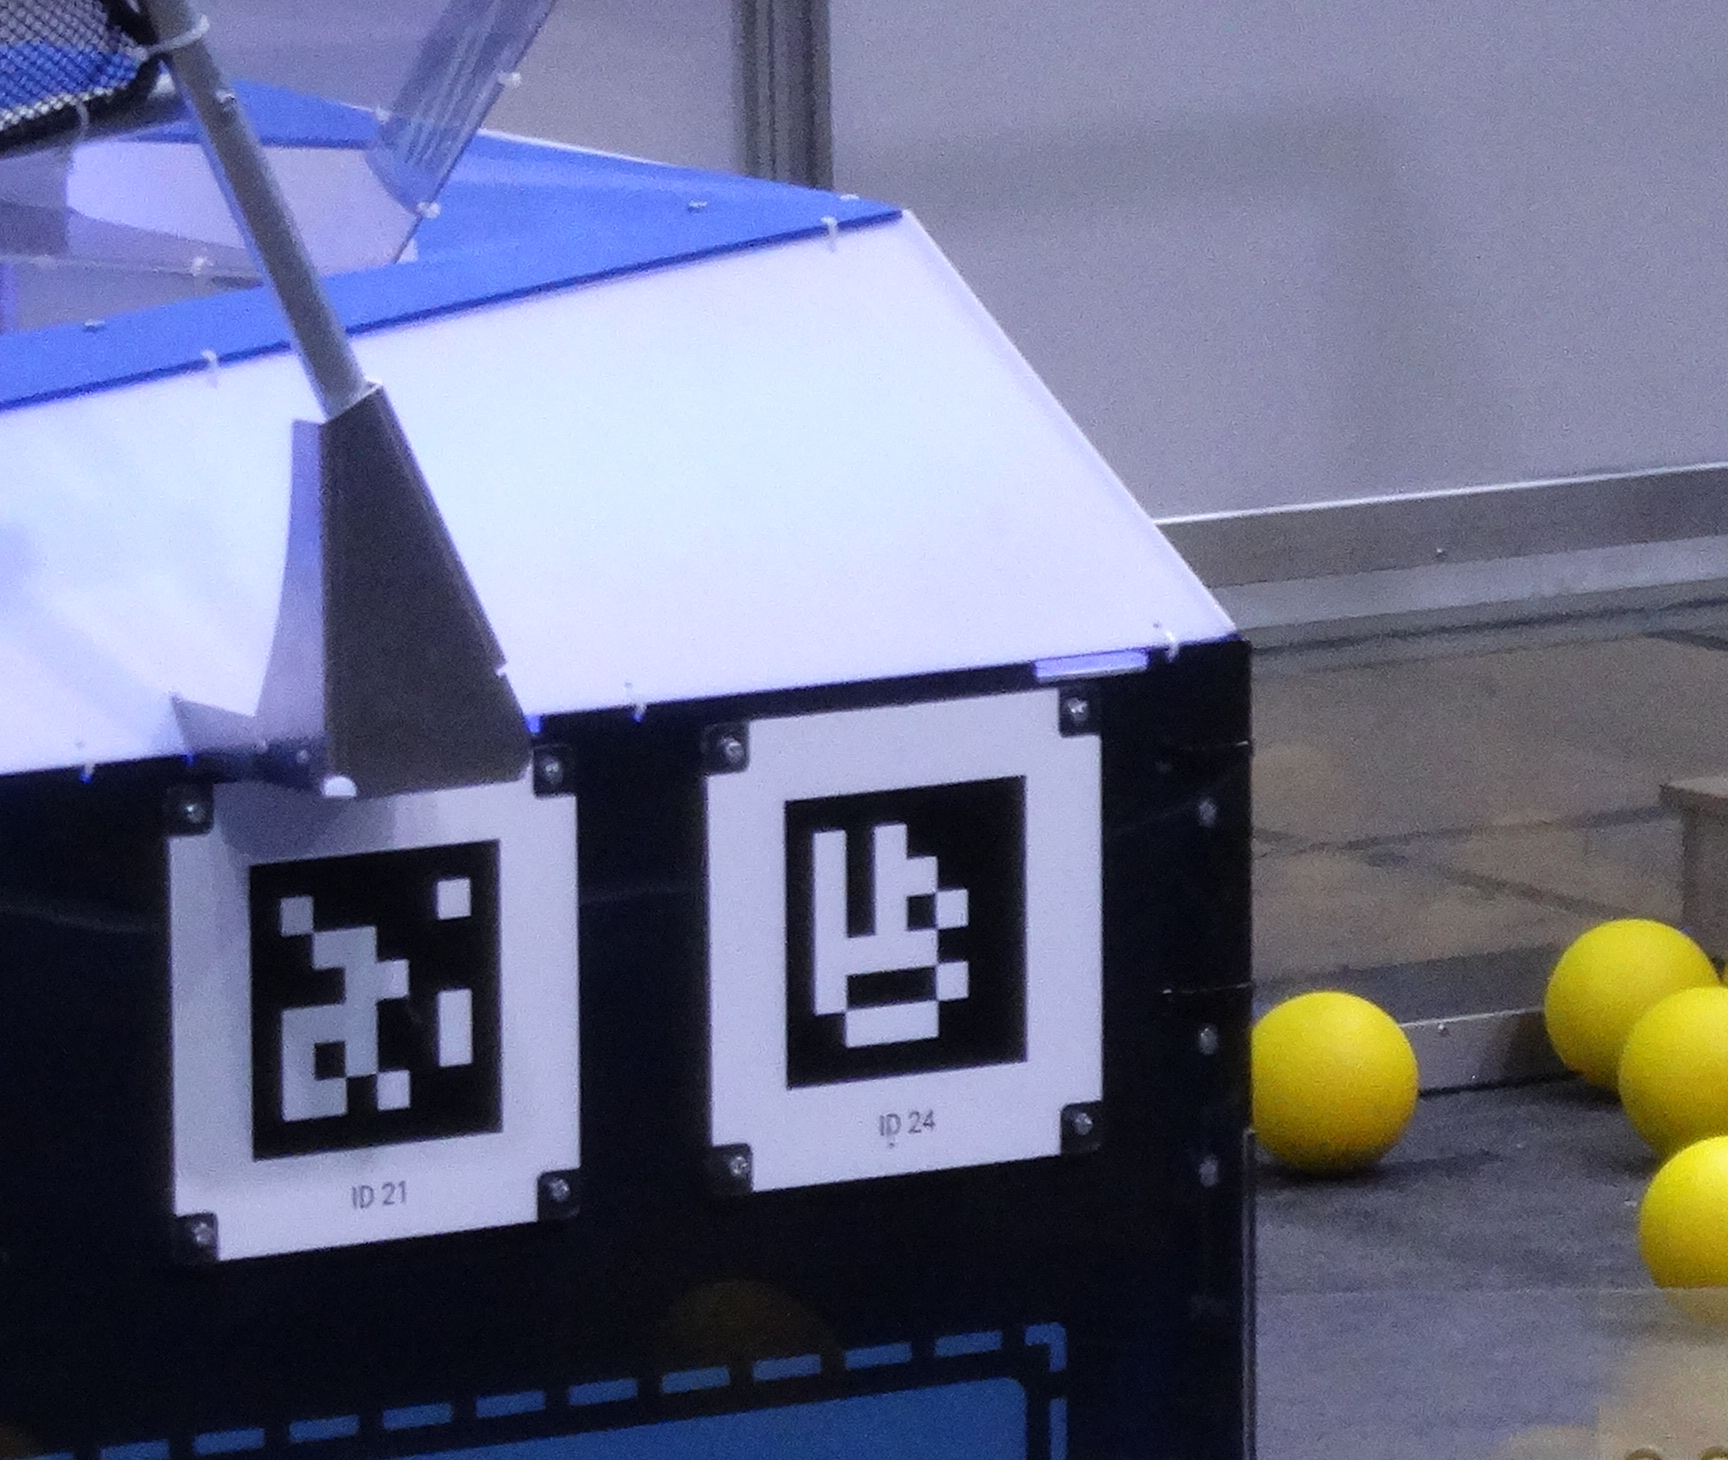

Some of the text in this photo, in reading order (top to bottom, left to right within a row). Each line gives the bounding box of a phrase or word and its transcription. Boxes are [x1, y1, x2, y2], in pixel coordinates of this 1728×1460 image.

[879, 1110, 936, 1137] ID 24
[351, 1180, 406, 1210] ID 21
